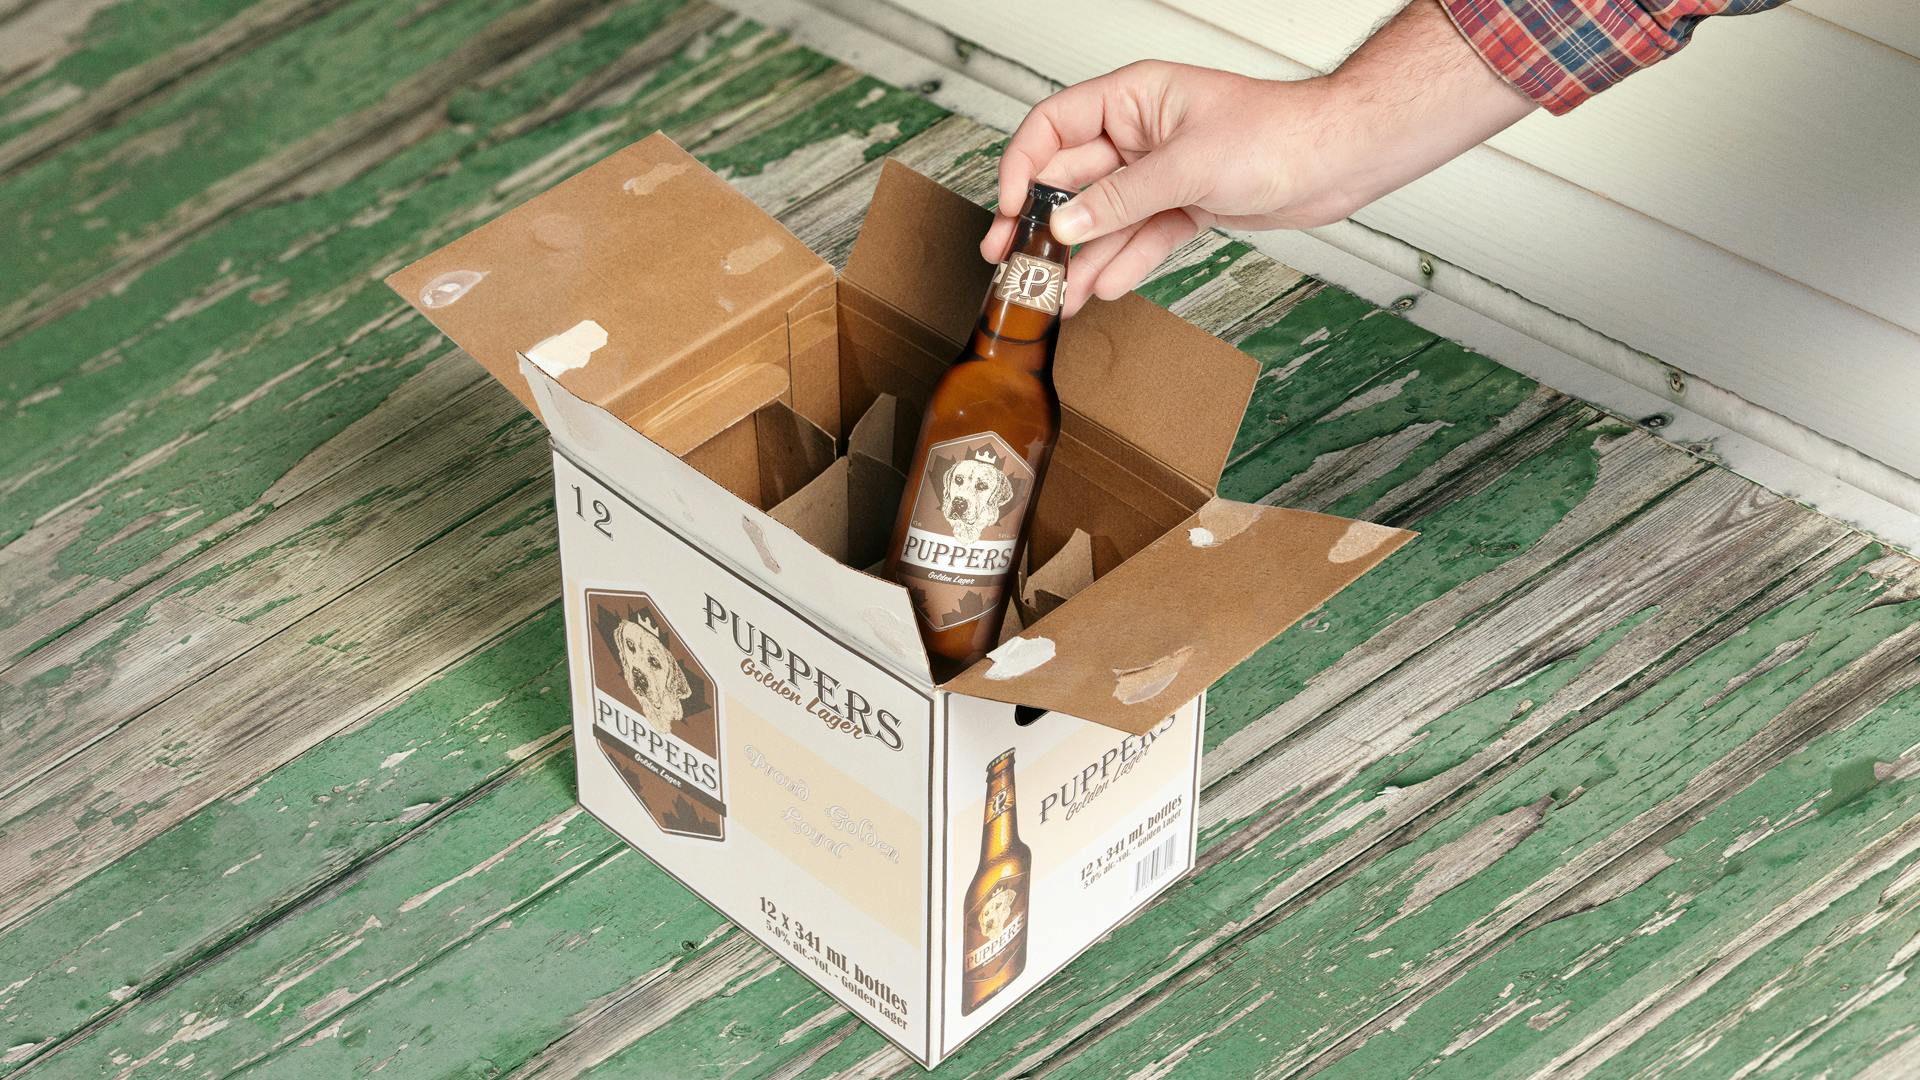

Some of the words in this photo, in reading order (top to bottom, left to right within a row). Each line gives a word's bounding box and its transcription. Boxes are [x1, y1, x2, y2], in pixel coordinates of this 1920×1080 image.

[1020, 264, 1051, 300] P
[570, 483, 614, 541] 12
[904, 536, 1013, 570] PUPPERS
[928, 571, 953, 583] Golden
[953, 574, 976, 586] Lager
[702, 592, 904, 751] PUPPERS
[740, 658, 802, 706] Golden
[806, 697, 863, 740] Lager
[598, 699, 719, 790] PUPPERS
[634, 753, 660, 774] Golden
[660, 769, 682, 788] Lager
[1065, 779, 1110, 821] Golden
[825, 805, 900, 864] Golden
[1080, 861, 1093, 881] 12
[1106, 838, 1125, 862] 341
[1128, 823, 1145, 845] mL
[1147, 793, 1183, 830] bottles
[760, 896, 777, 920] 12
[795, 921, 820, 953] 341
[827, 946, 850, 974] mL
[854, 963, 908, 1016] bottles
[766, 920, 790, 945] 5.0%
[841, 975, 876, 1009] Golden
[879, 1002, 908, 1031] Lager
